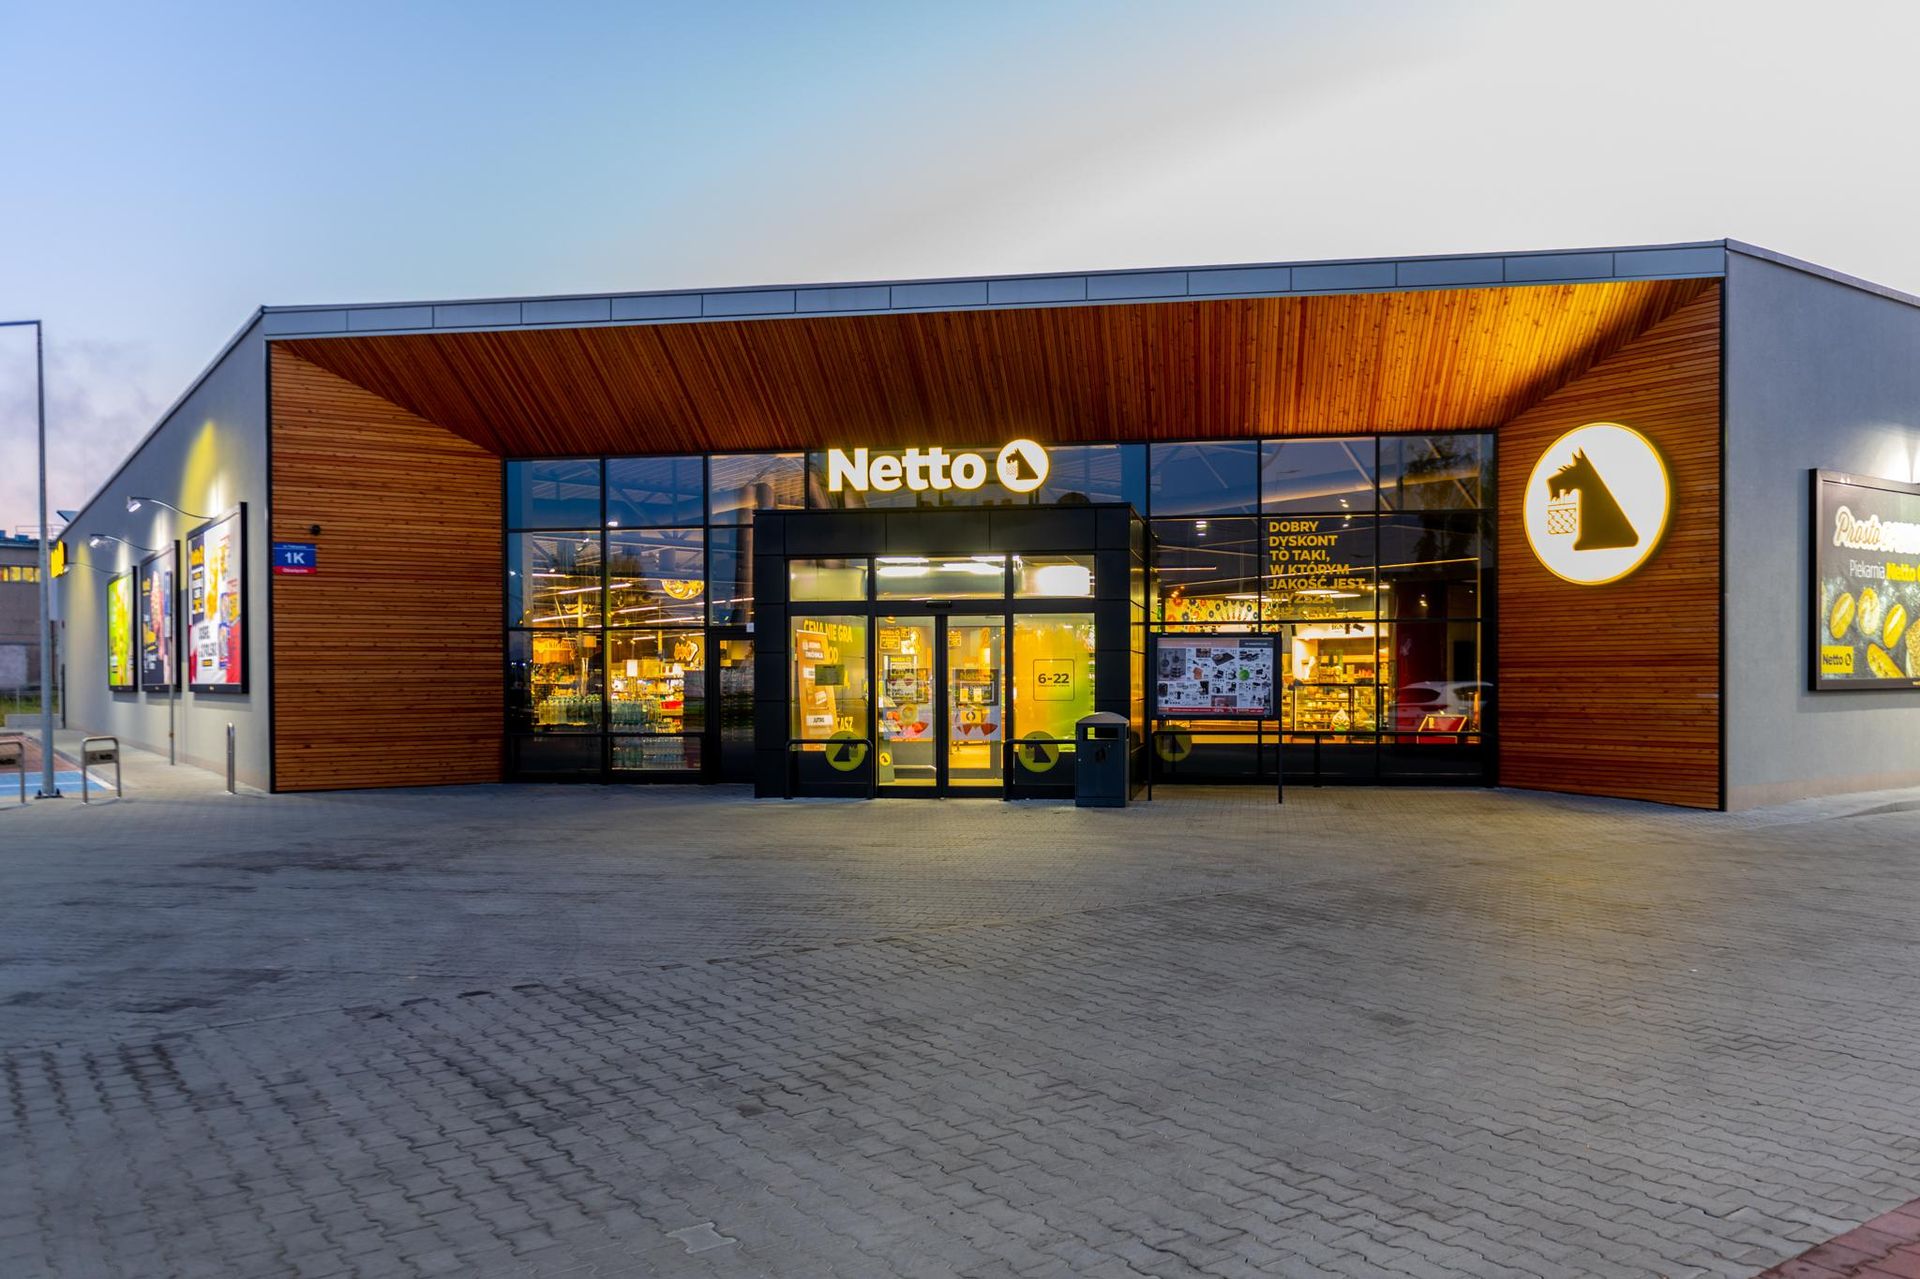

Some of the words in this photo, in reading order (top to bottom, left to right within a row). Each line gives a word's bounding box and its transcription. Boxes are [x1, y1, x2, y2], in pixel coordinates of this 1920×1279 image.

[827, 446, 987, 492] Netto
[1269, 521, 1319, 532] DOBRY
[1835, 509, 1880, 547] Prosto
[1269, 535, 1338, 546] DYSKONT
[285, 552, 304, 564] 1K
[1269, 550, 1289, 561] TO
[1292, 550, 1330, 562] TAKI,
[1269, 564, 1284, 575] W
[1288, 561, 1350, 575] KTÓRYM
[1849, 559, 1885, 579] Piekarnia
[1269, 575, 1327, 590] JAKOŚĆ
[1330, 578, 1366, 589] JEST
[825, 623, 837, 641] NIE
[837, 624, 853, 642] GRA
[1823, 654, 1843, 665] Netto
[1038, 673, 1070, 684] 6-22
